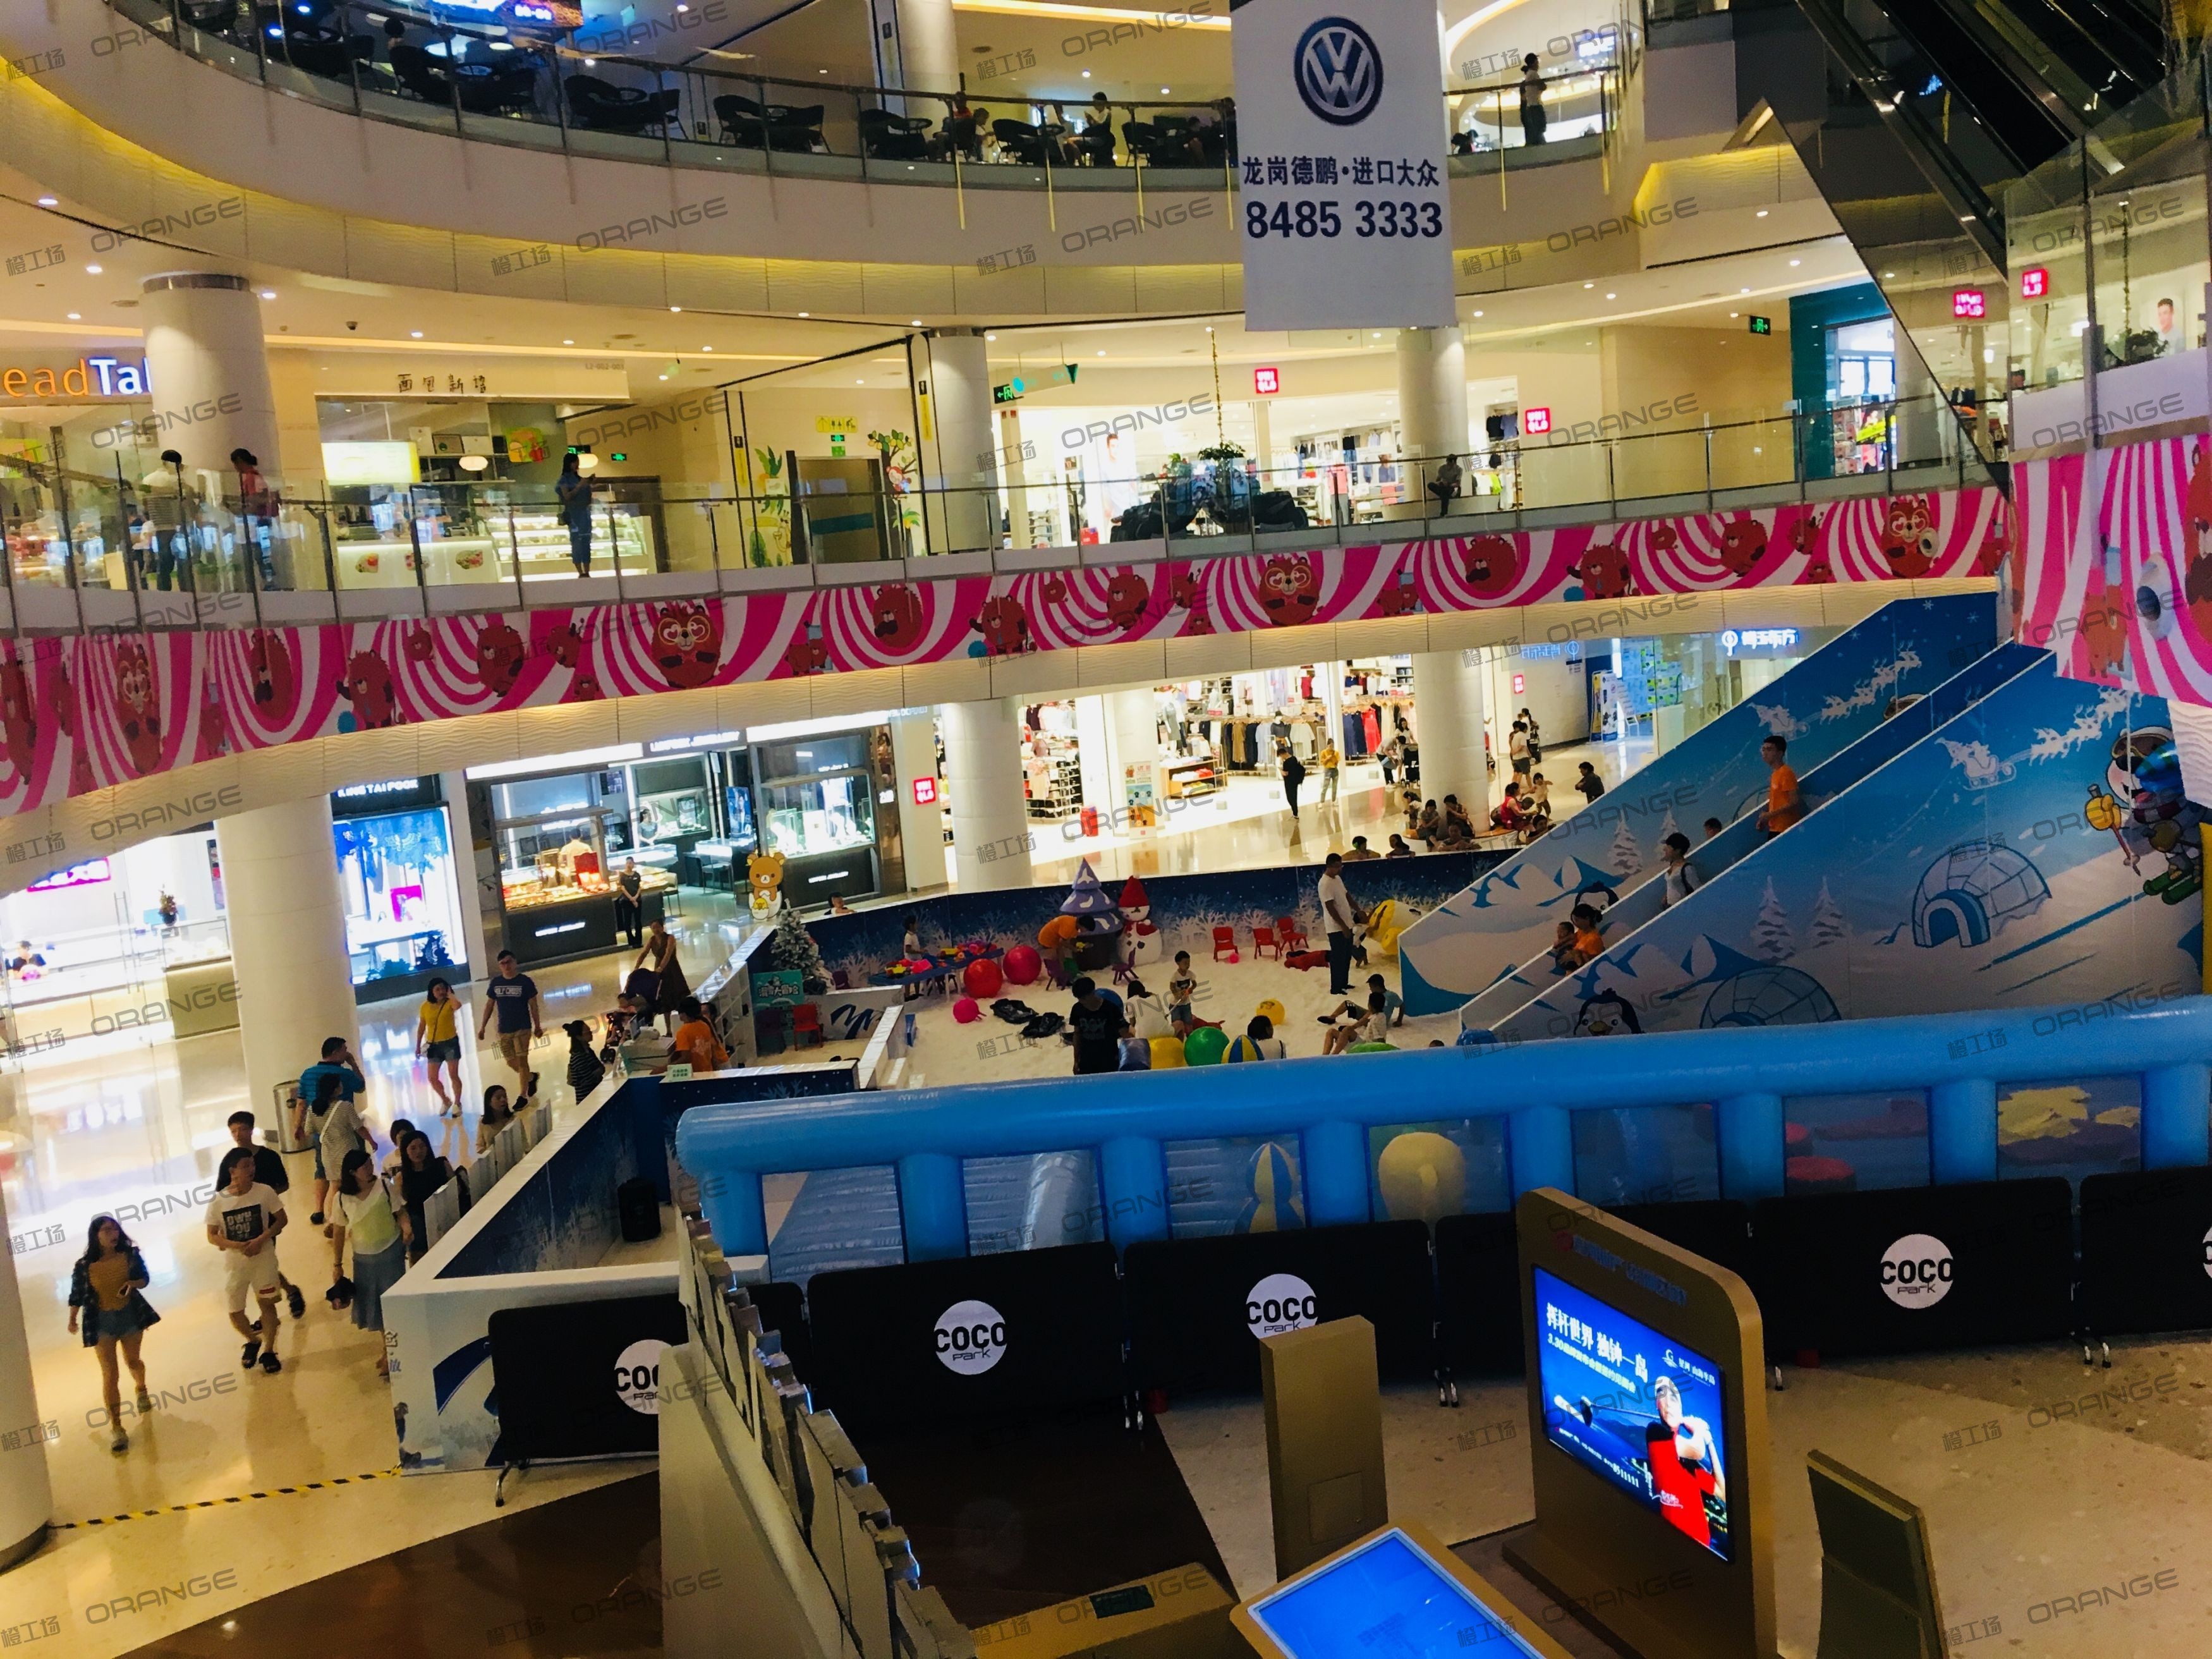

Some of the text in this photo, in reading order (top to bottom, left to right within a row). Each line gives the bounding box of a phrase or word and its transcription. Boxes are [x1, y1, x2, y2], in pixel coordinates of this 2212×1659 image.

[1247, 201, 1443, 239] 8485 3333
[3, 356, 152, 397] eadTal
[1880, 1257, 1954, 1285] COCO
[1246, 1294, 1318, 1325] COCO
[934, 1321, 1007, 1354] COCO
[614, 1364, 659, 1392] CO
[633, 1391, 658, 1400] Par
